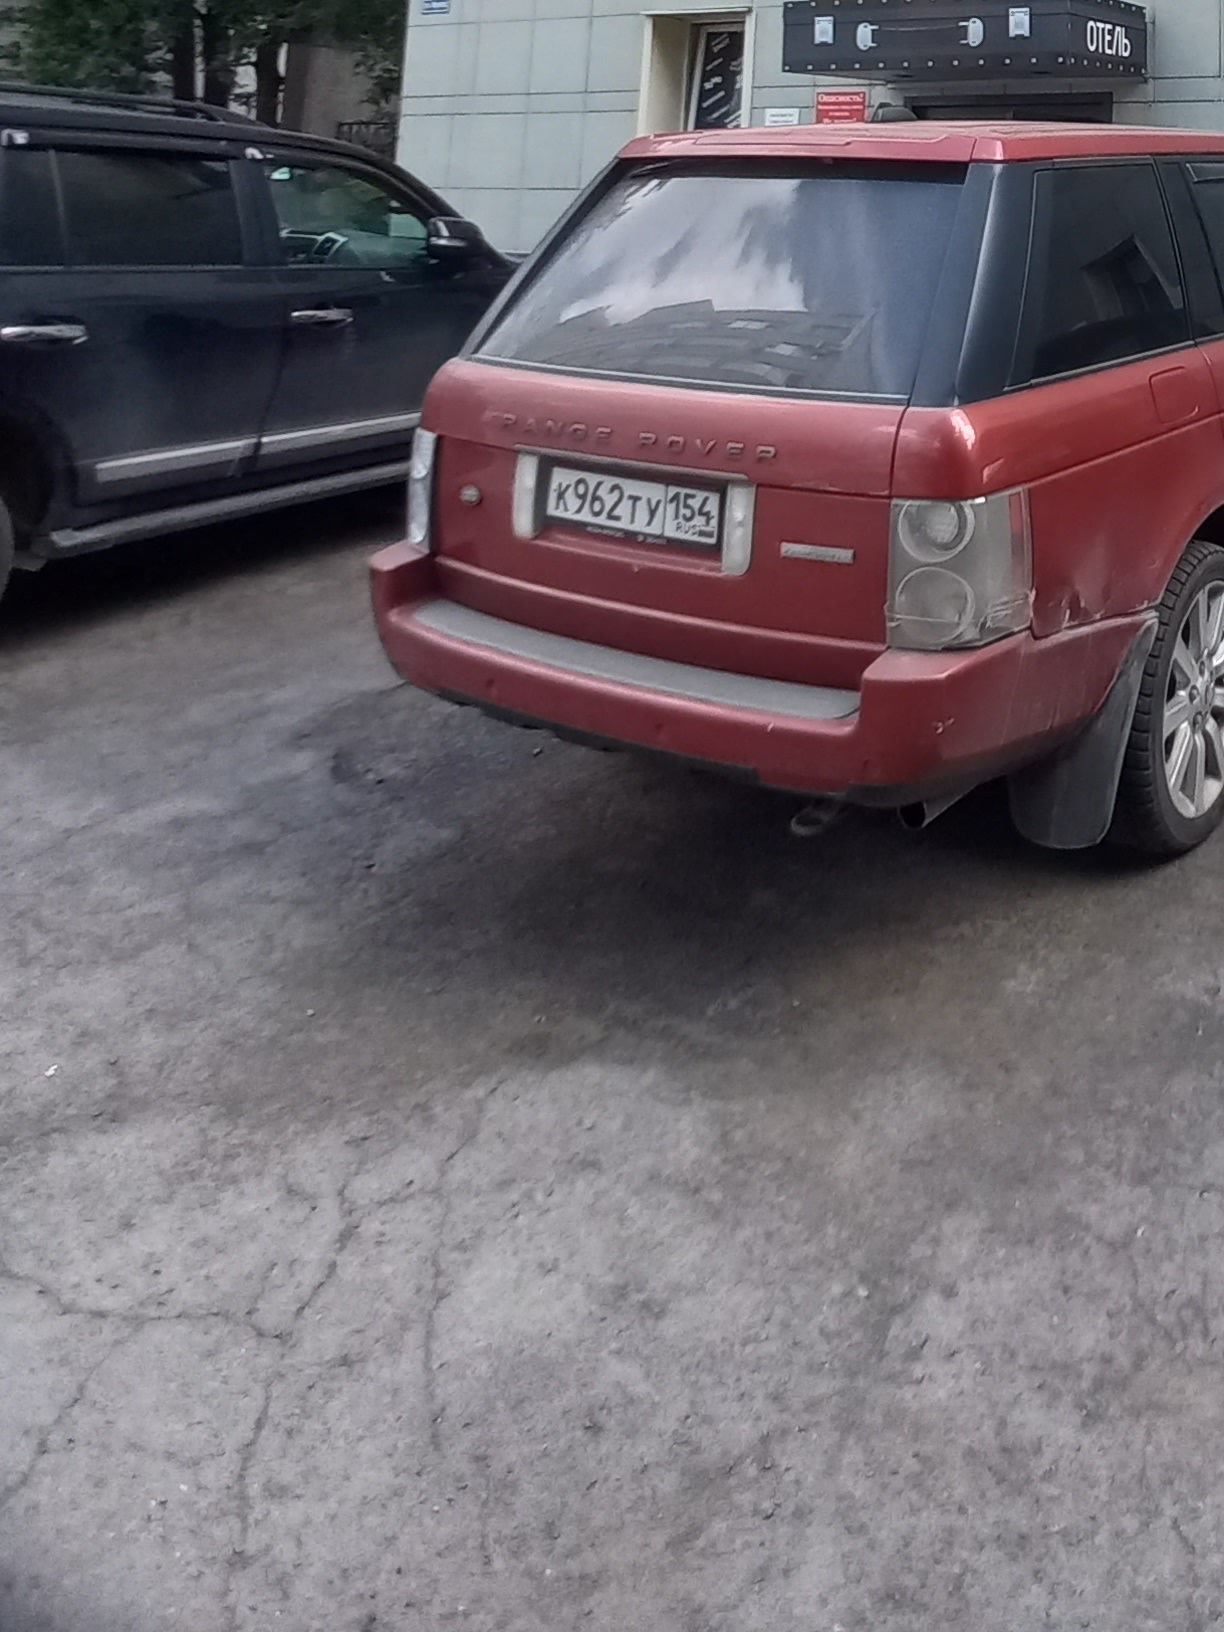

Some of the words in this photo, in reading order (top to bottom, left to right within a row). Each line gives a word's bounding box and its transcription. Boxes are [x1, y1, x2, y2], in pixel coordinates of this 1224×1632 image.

[1086, 18, 1131, 58] ОТЕЛЬ
[503, 413, 613, 439] RANGE
[638, 431, 778, 461] ROVER
[555, 477, 662, 527] К962ТУ
[668, 490, 716, 528] 154
[675, 521, 700, 537] RUS
